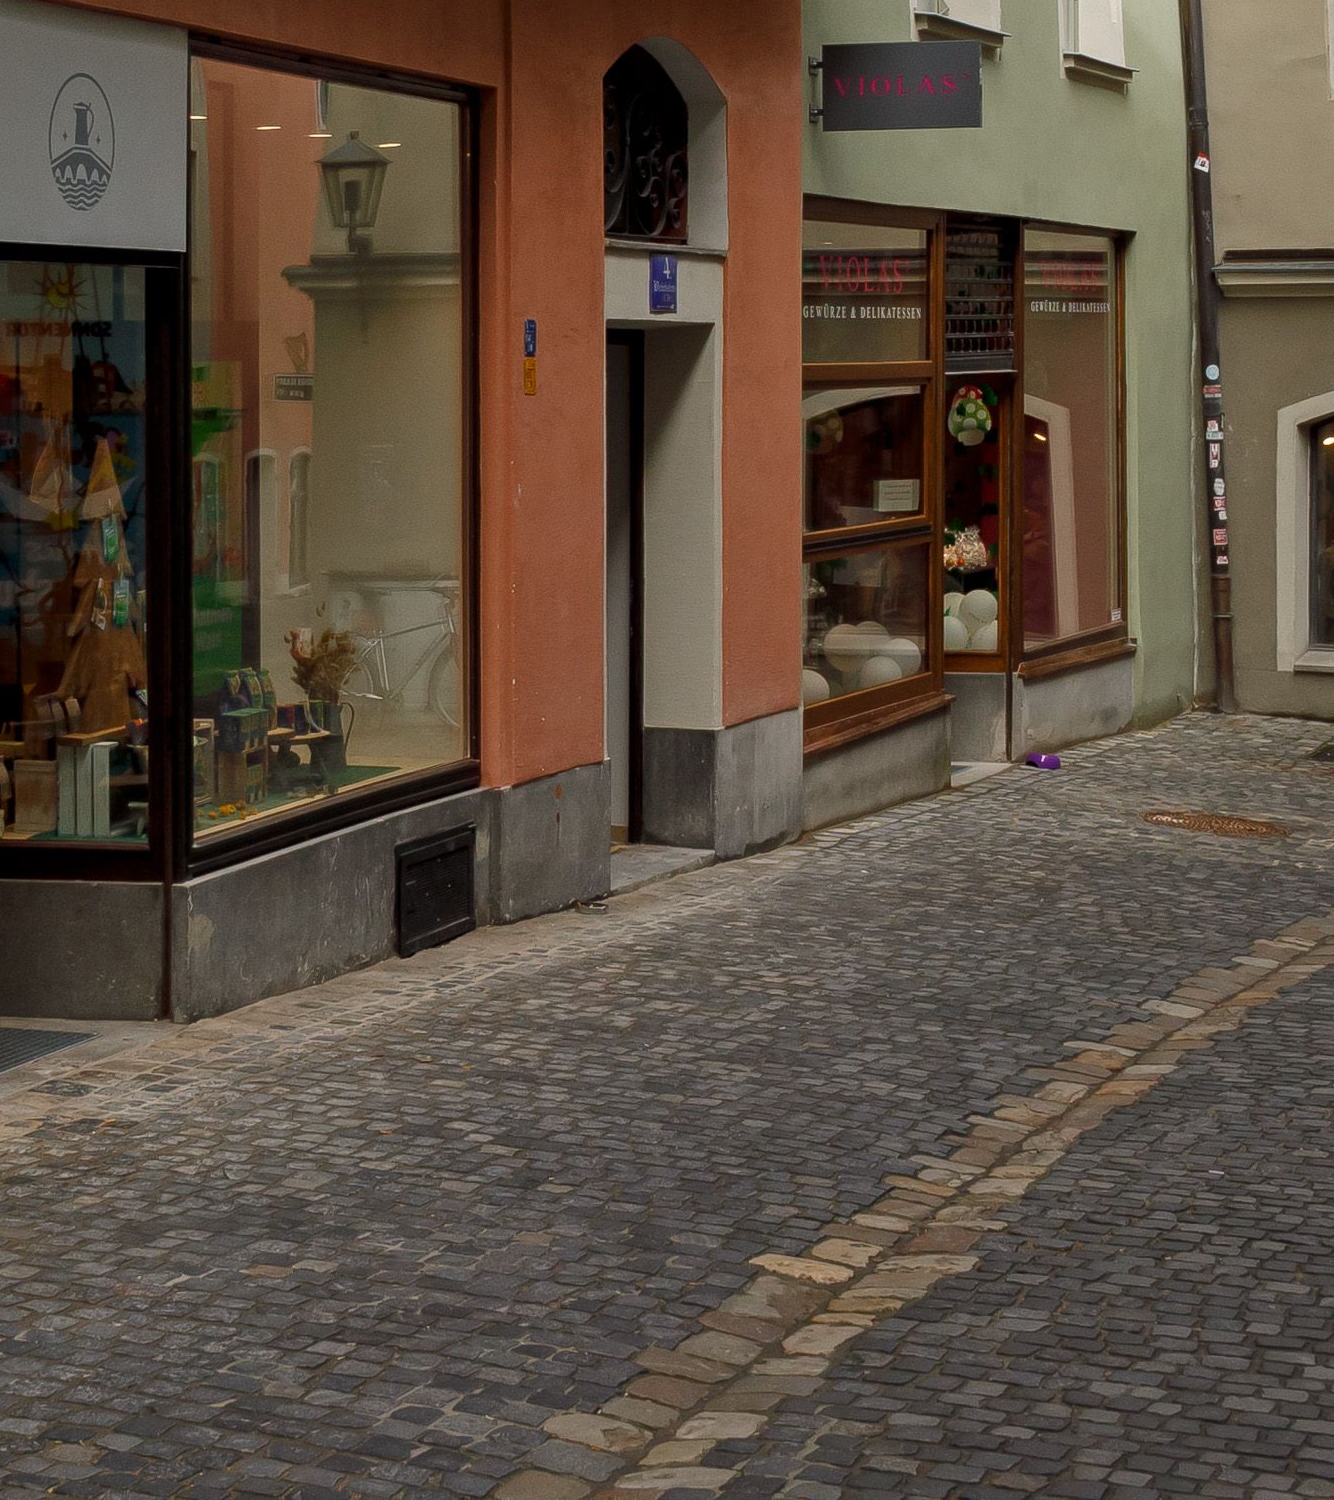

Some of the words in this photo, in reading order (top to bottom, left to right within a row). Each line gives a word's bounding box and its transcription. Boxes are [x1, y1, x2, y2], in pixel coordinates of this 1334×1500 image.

[833, 73, 957, 98] VIOLAS
[818, 253, 903, 294] VIOLAS
[802, 303, 847, 319] GEWÜRZE
[850, 306, 857, 319] &
[860, 306, 922, 320] DELIKATESSEN
[1030, 299, 1060, 313] GEWÜRZE
[1068, 302, 1111, 314] DELIKATESSEN
